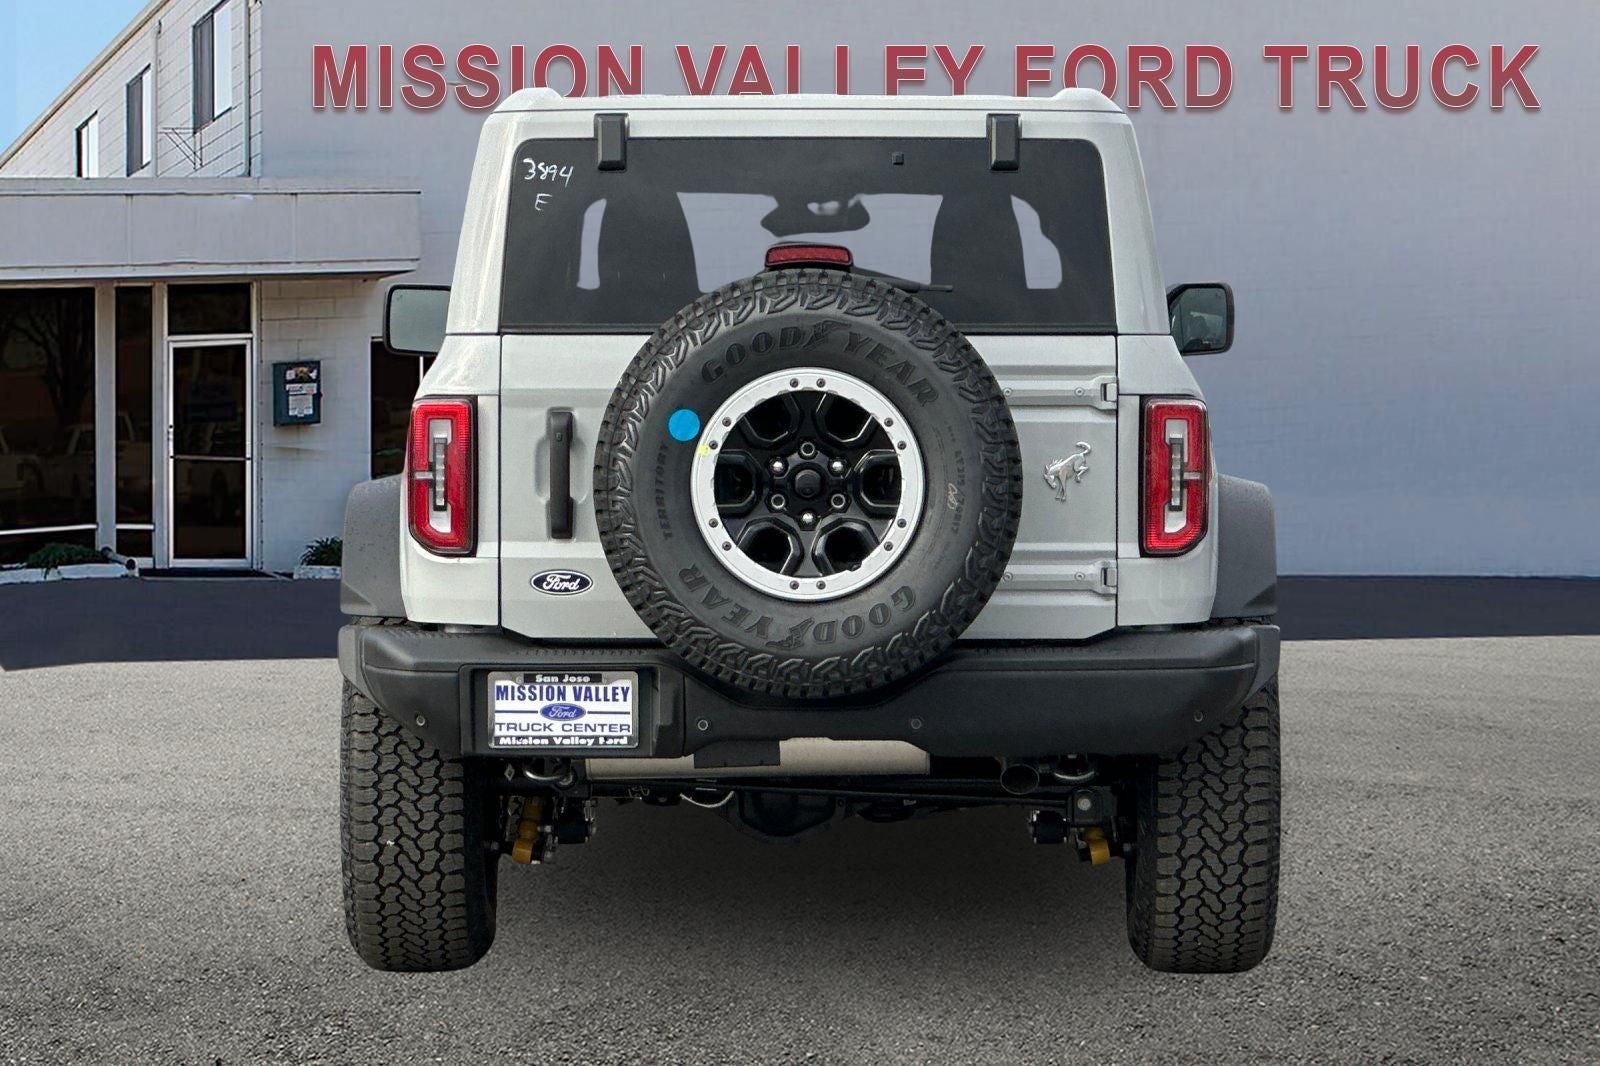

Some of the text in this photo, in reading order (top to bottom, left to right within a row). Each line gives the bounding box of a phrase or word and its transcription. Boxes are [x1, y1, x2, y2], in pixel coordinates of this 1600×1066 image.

[312, 44, 1540, 109] MISSION VALLEY FORD TRUCK
[523, 158, 574, 188] 3894
[542, 574, 581, 590] Ford
[535, 674, 591, 683] San Jose
[495, 685, 630, 702] MISSION VALLEY
[549, 705, 577, 719] Ford
[496, 722, 631, 733] TRUCK CENTER
[552, 736, 594, 747] Valley
